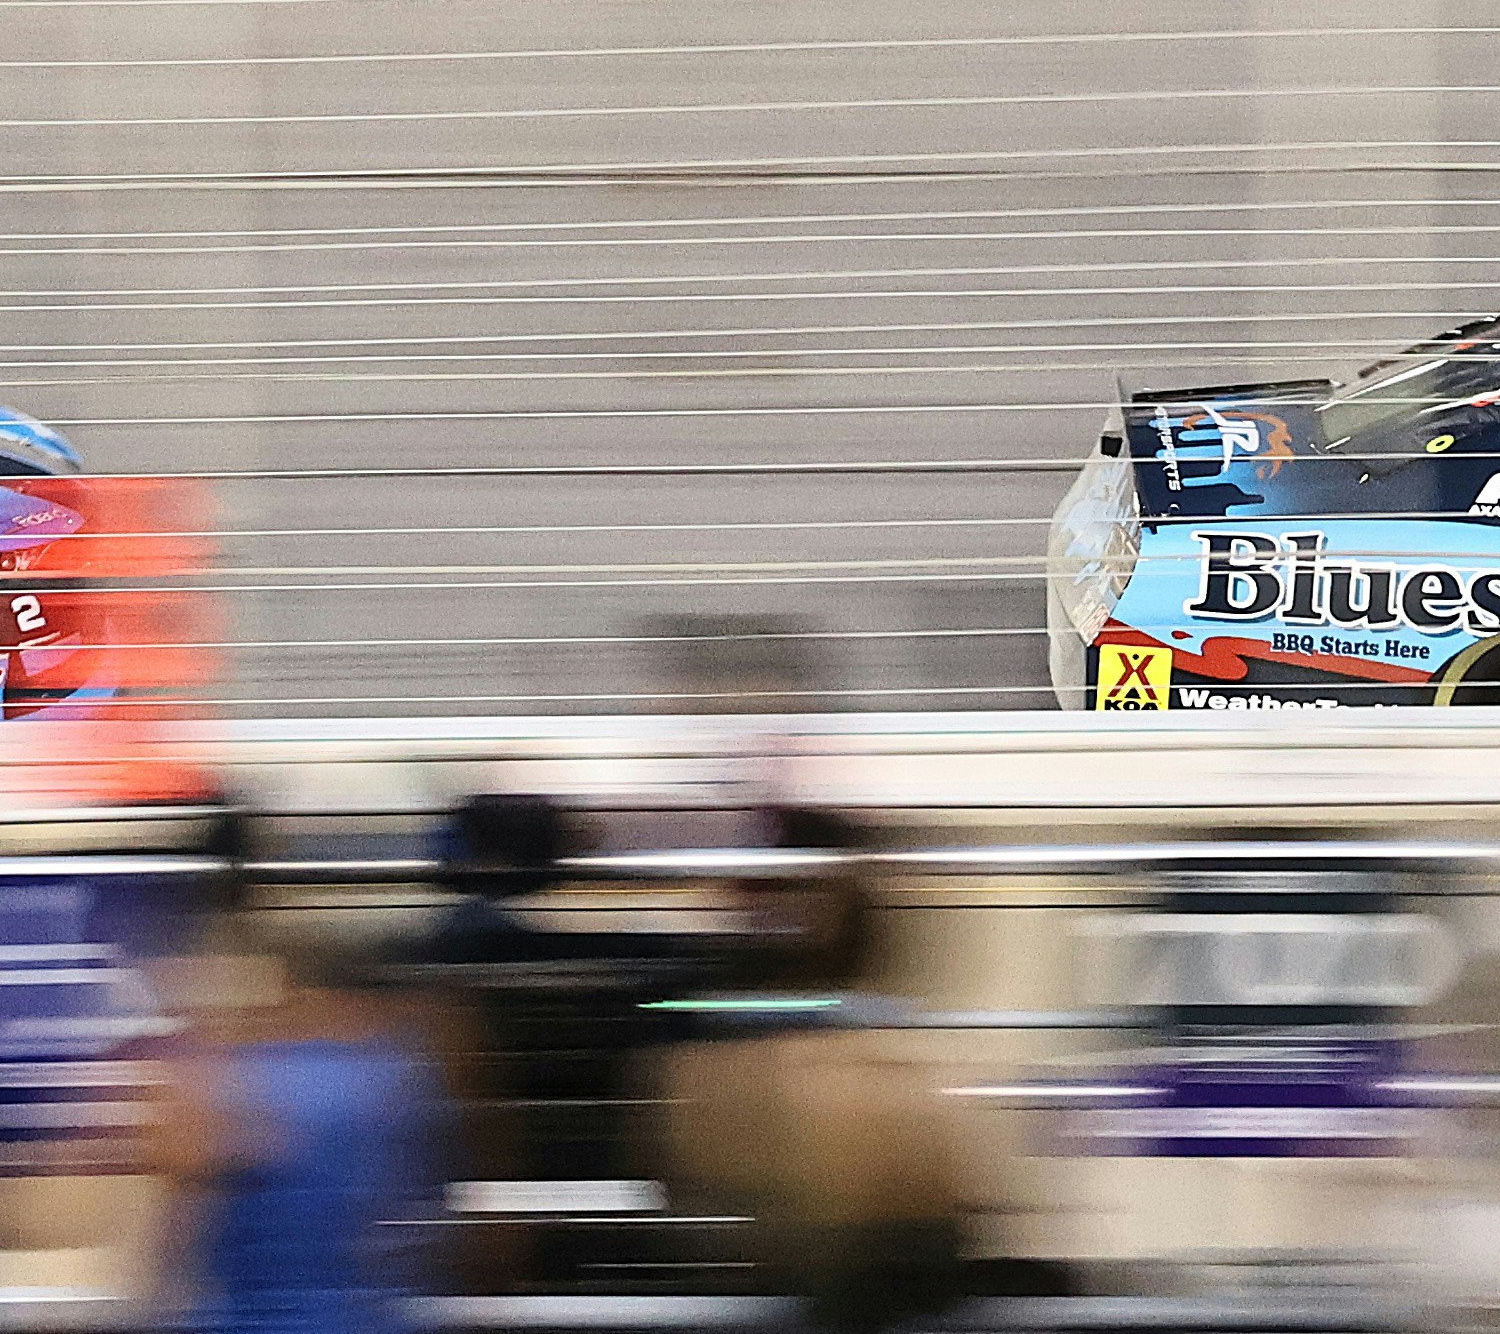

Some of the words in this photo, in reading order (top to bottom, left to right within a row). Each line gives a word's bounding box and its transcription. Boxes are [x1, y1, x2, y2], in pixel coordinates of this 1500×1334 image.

[11, 596, 46, 632] 2
[1272, 633, 1314, 653] BBQ
[1320, 634, 1380, 657] Starts
[1385, 639, 1430, 659] Here
